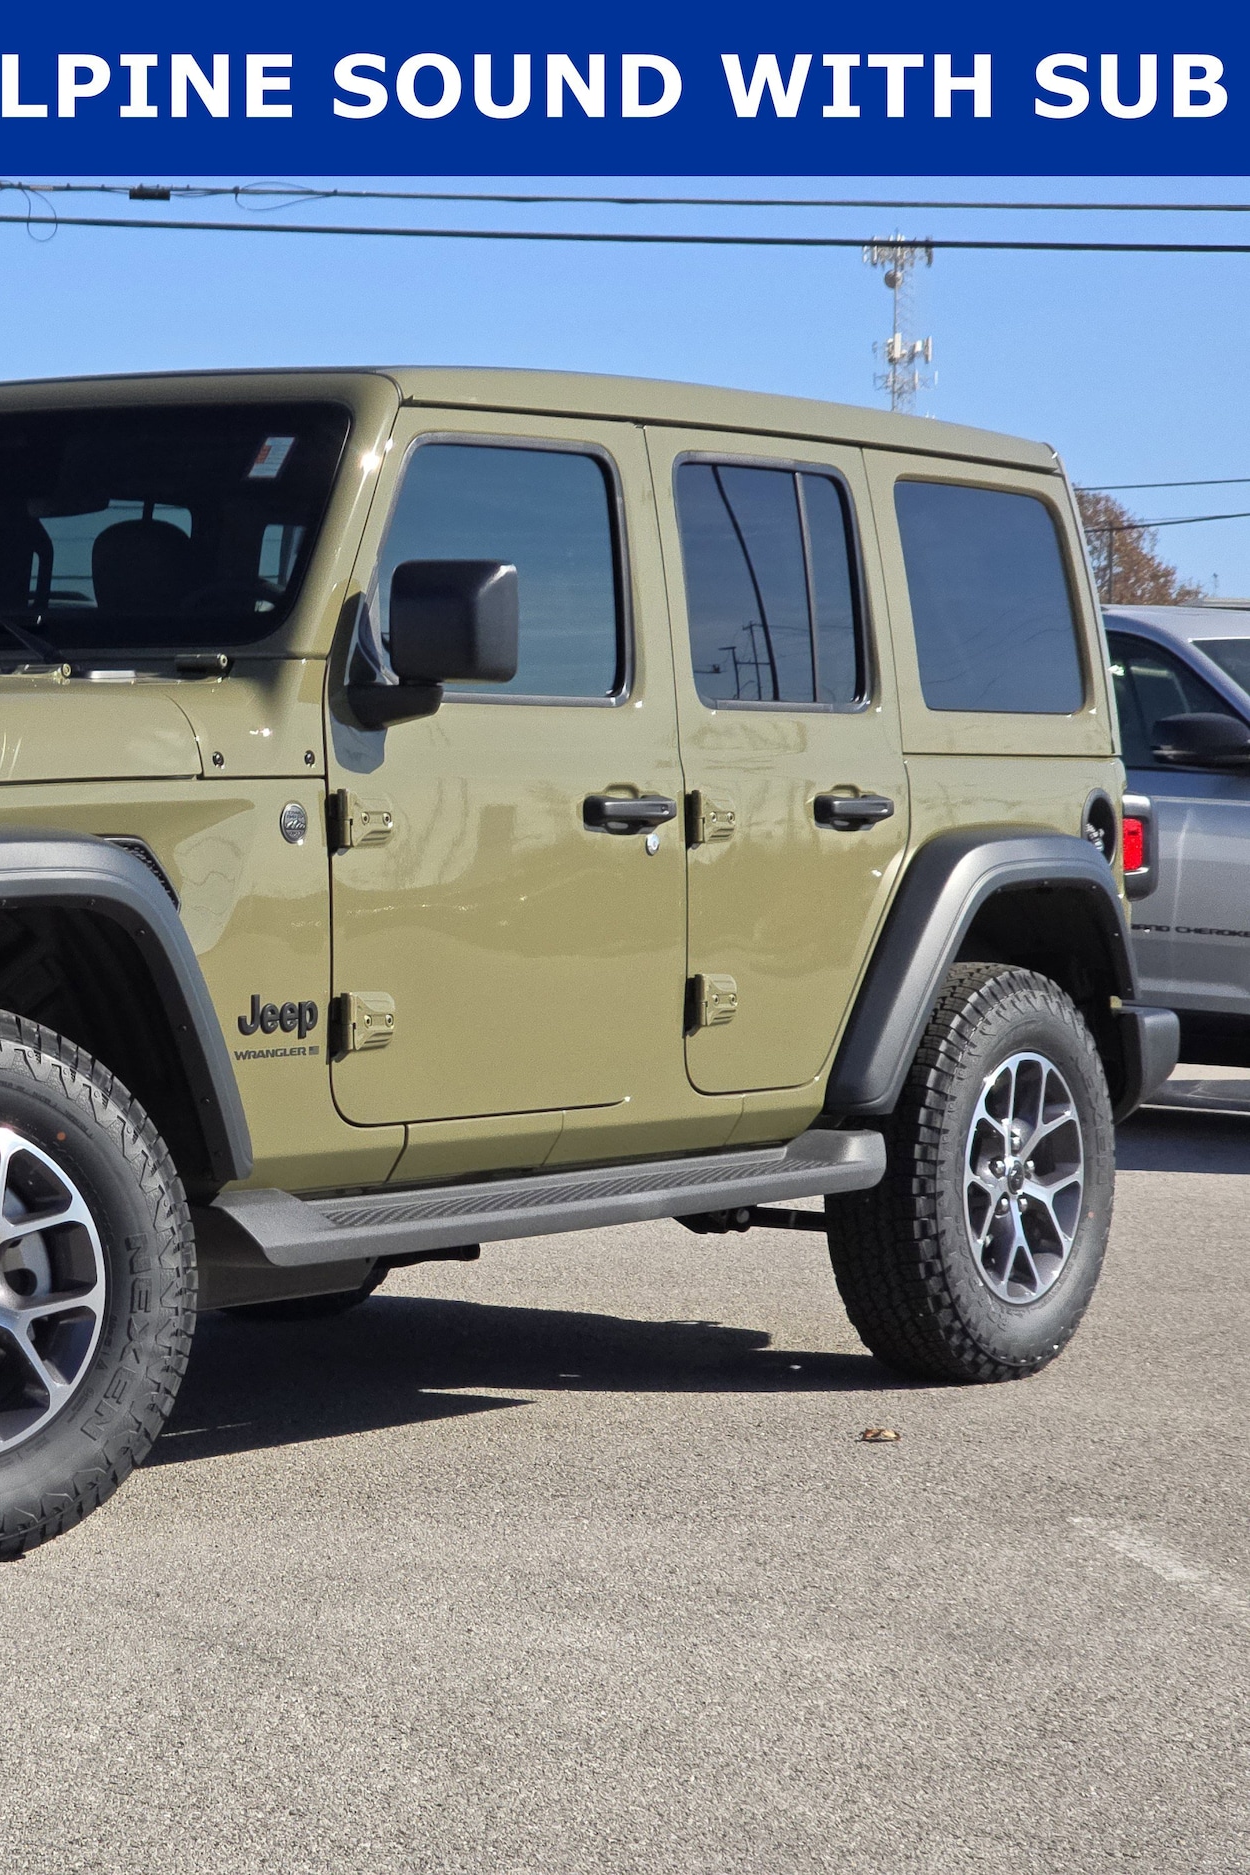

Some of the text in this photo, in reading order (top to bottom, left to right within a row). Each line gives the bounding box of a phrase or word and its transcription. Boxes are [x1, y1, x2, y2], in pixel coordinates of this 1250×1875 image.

[1175, 926, 1250, 938] CHEROKE
[238, 994, 318, 1040] Jeep
[234, 1046, 307, 1061] WRANGLER
[80, 1232, 152, 1442] NEXEN
